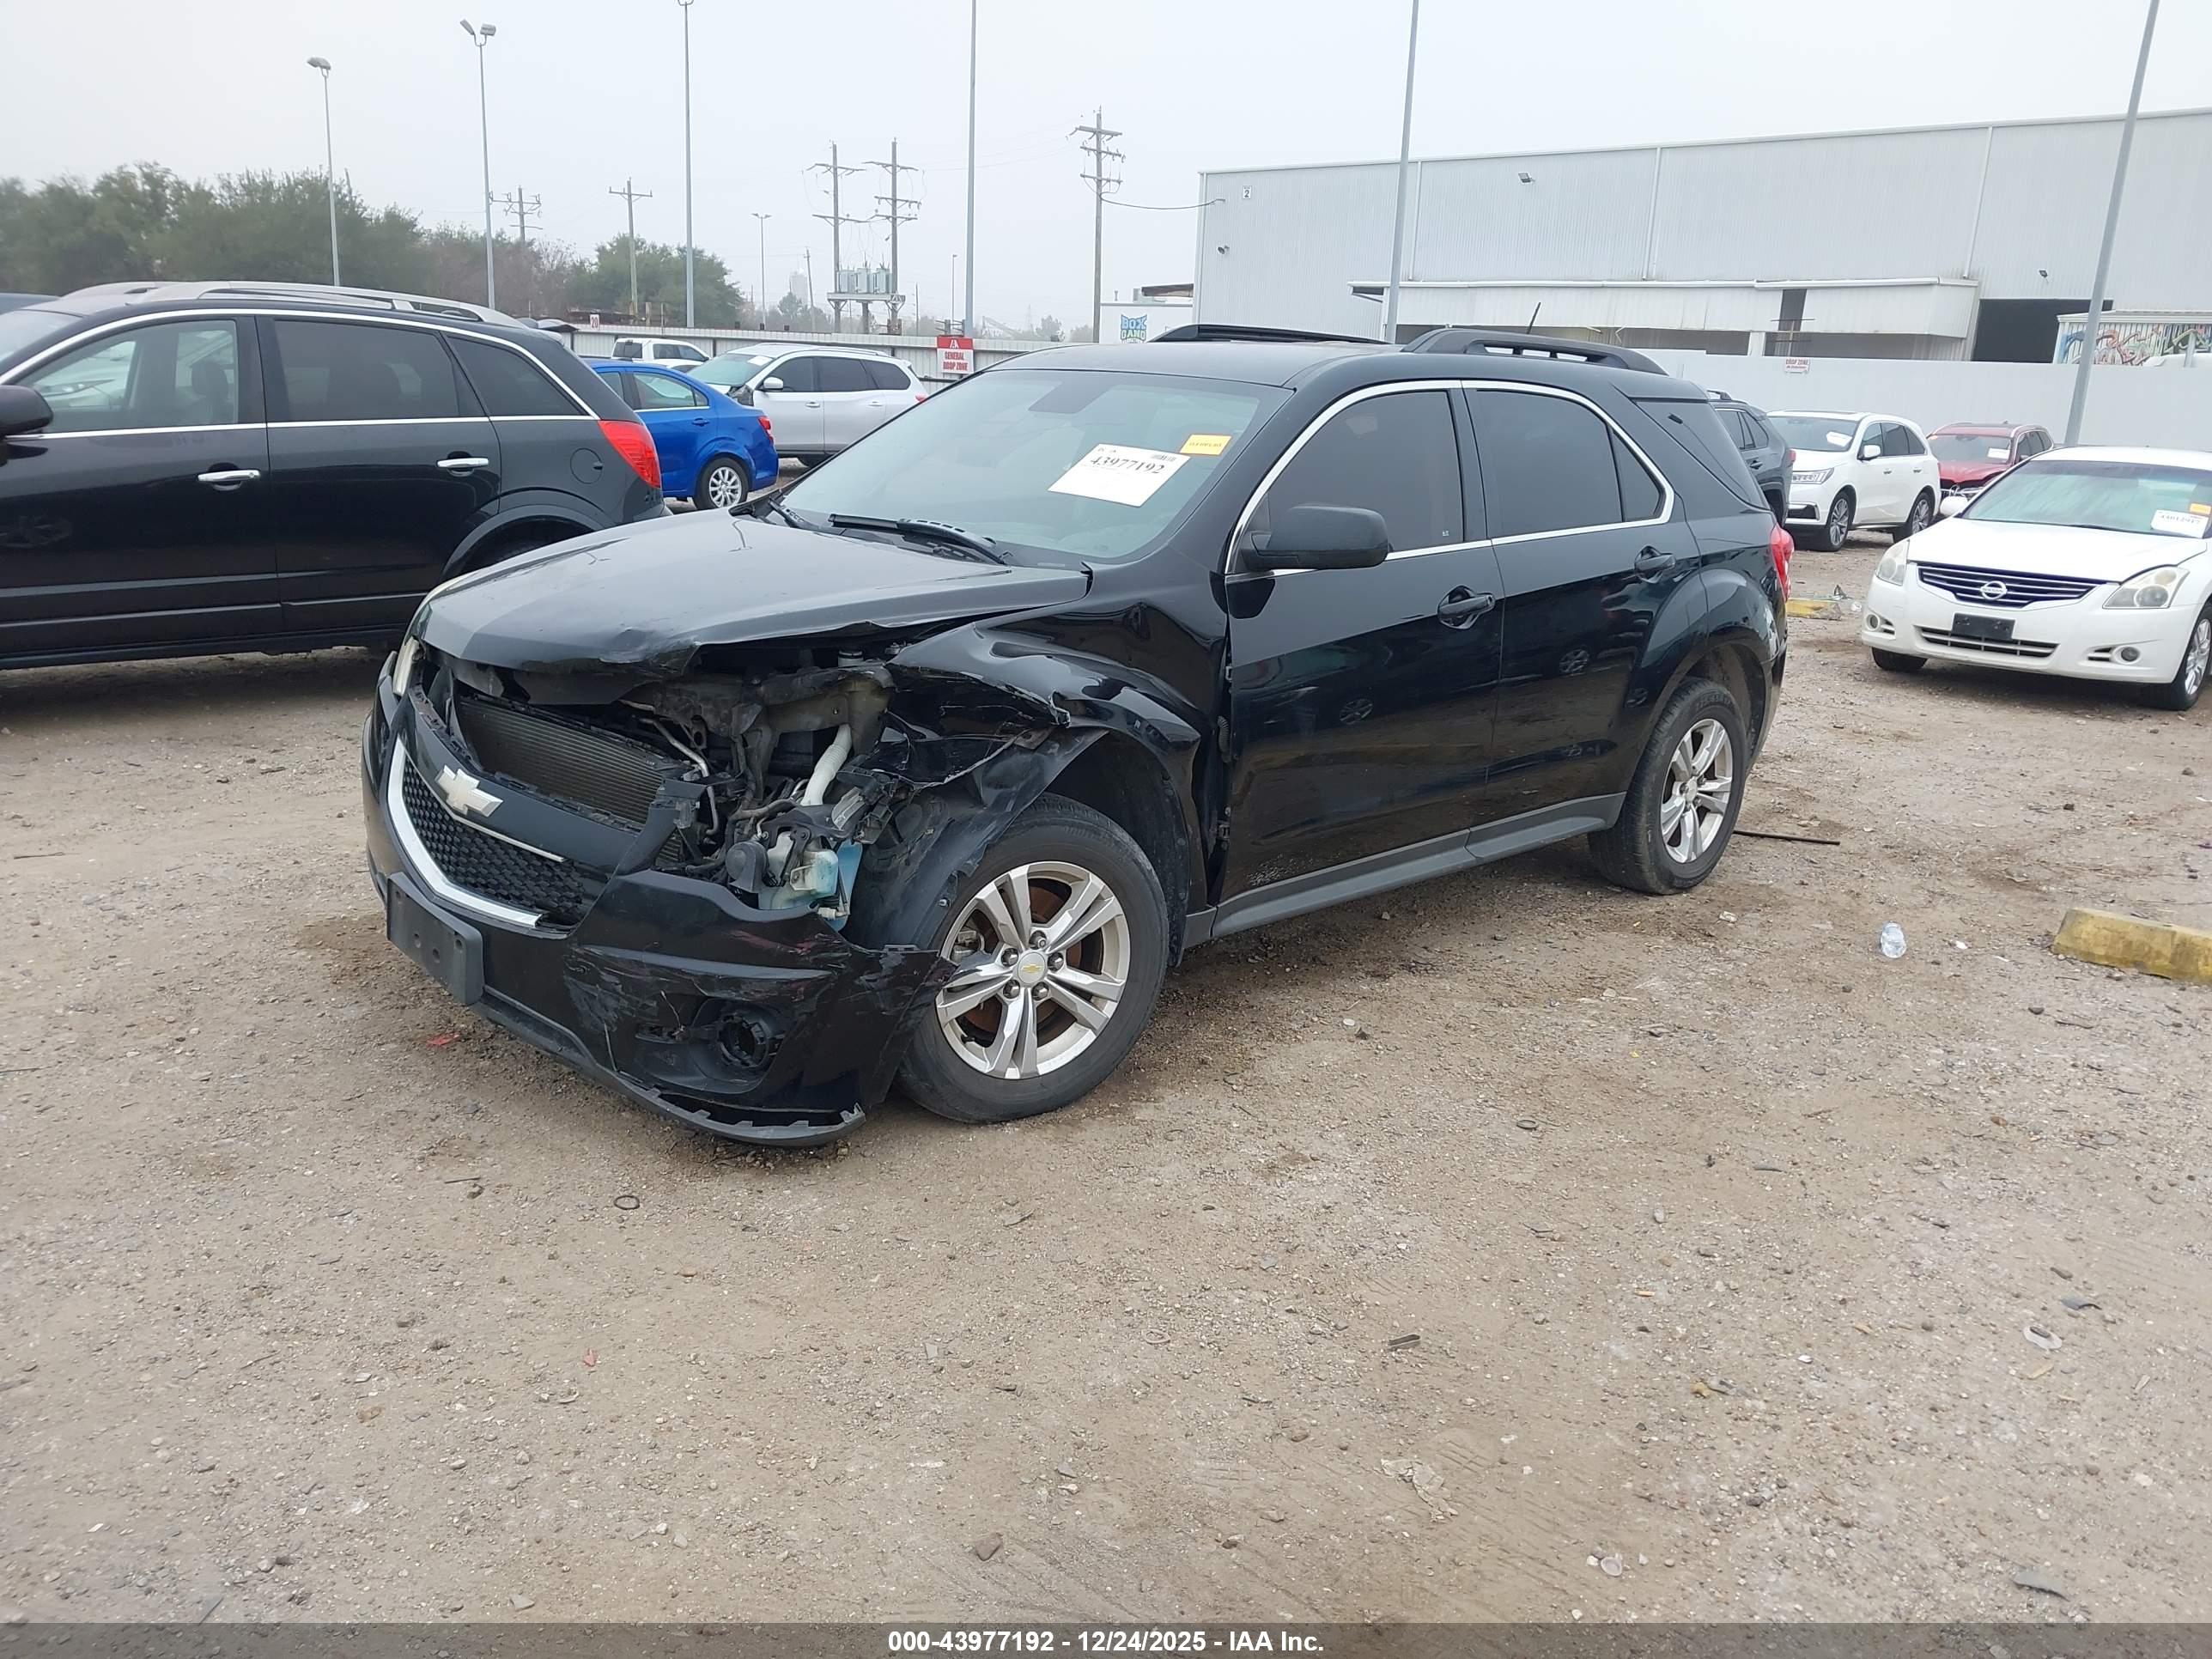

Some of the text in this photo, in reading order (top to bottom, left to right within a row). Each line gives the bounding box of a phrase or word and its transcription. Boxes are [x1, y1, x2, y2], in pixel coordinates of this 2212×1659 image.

[1243, 189, 1250, 198] 2
[1121, 314, 1147, 330] BOX
[1091, 455, 1165, 474] 43977192
